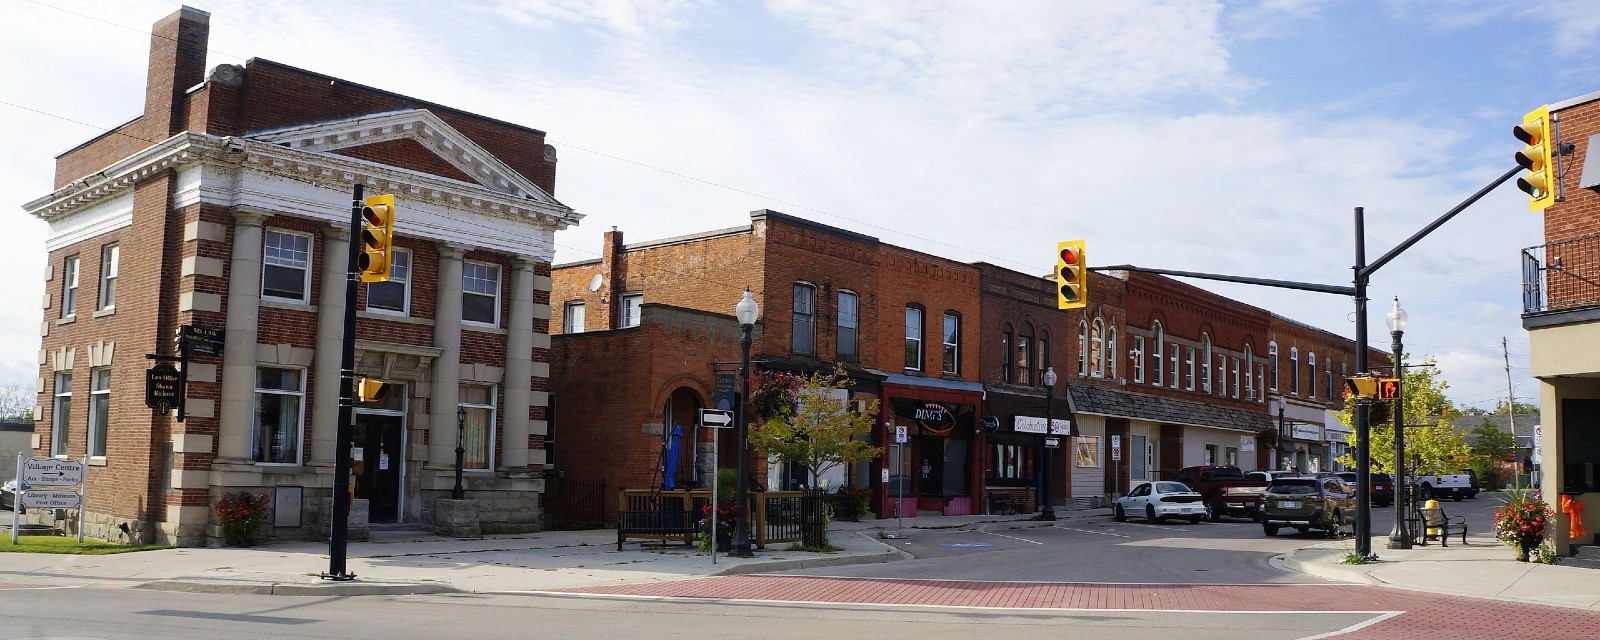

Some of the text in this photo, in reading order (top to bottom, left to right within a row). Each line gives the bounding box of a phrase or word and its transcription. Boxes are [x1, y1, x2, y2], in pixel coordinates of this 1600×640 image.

[204, 329, 217, 337] LAW
[915, 408, 943, 421] DING'S
[1017, 418, 1048, 432] Celebratin
